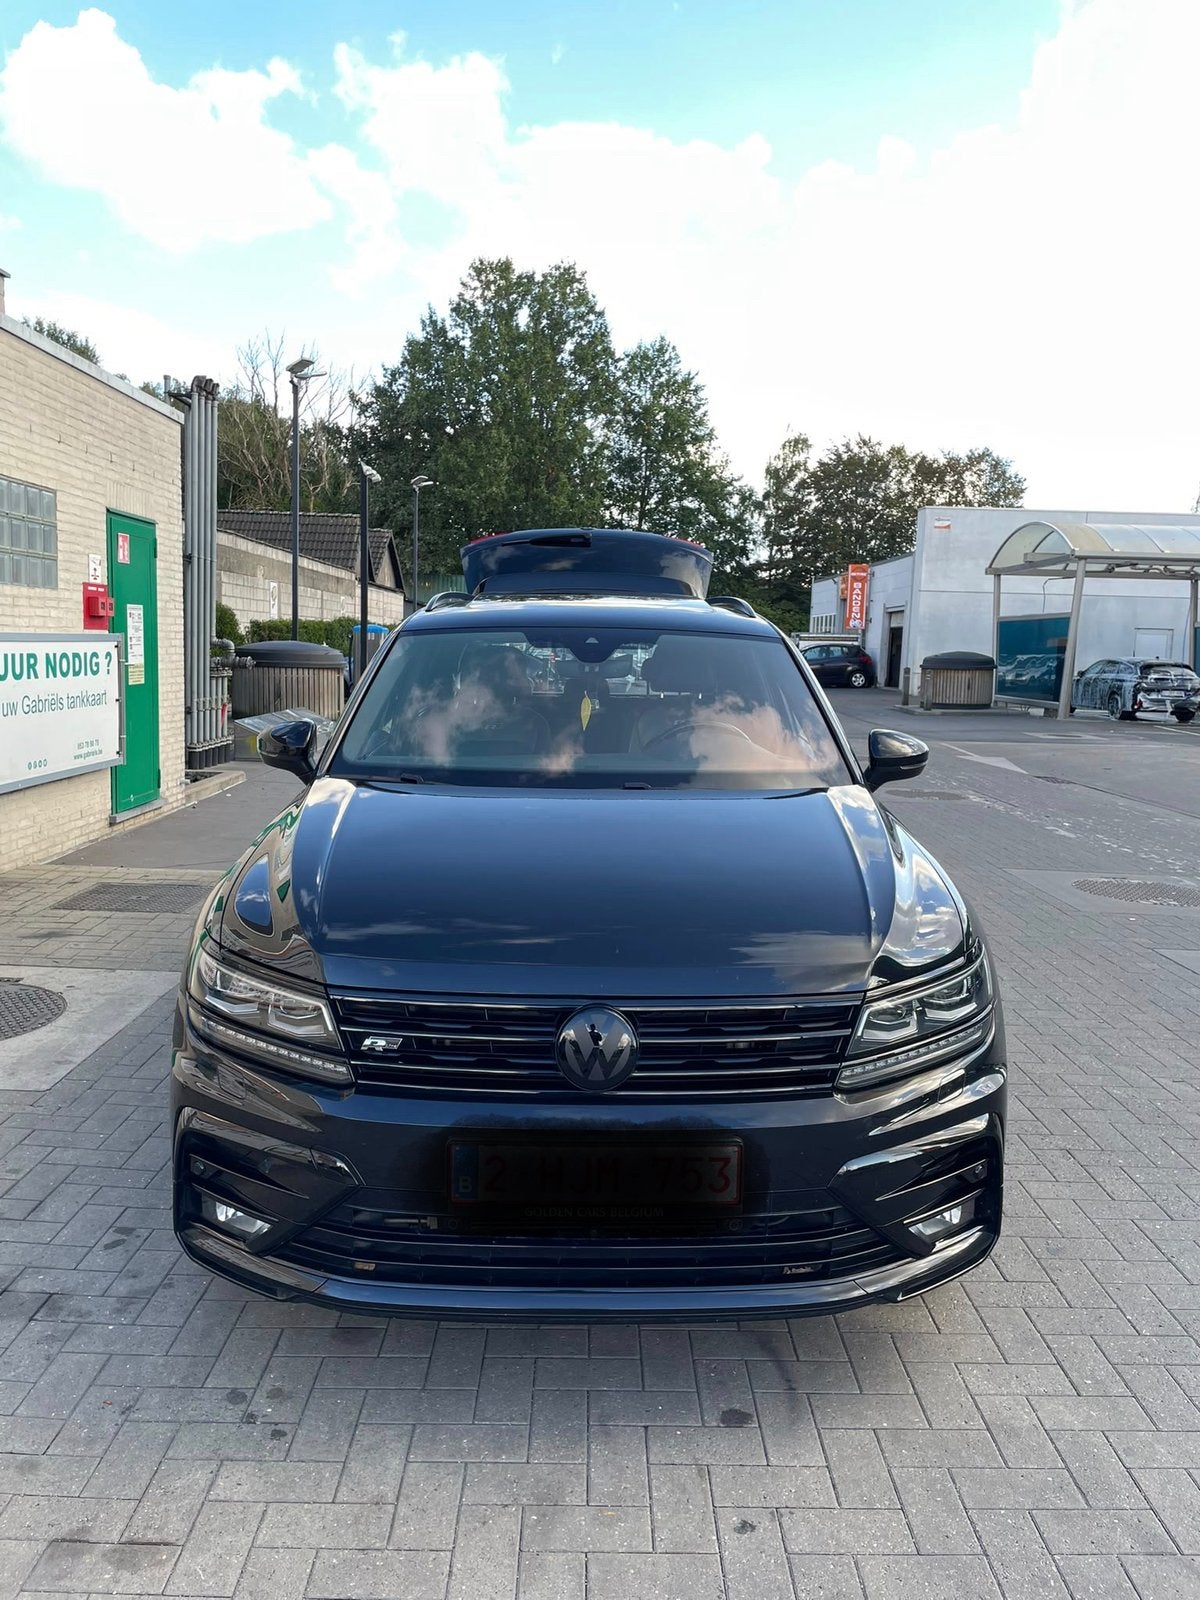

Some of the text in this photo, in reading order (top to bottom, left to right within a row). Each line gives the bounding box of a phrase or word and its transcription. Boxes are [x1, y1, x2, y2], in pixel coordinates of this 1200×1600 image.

[851, 582, 862, 619] BANDEN
[45, 652, 100, 678] NODIG
[105, 651, 112, 675] ?
[2, 690, 107, 717] uw Gabriëls tankkaart
[458, 1176, 473, 1192] B
[524, 1207, 573, 1217] GOLDEN
[610, 1207, 664, 1217] BELGIUM
